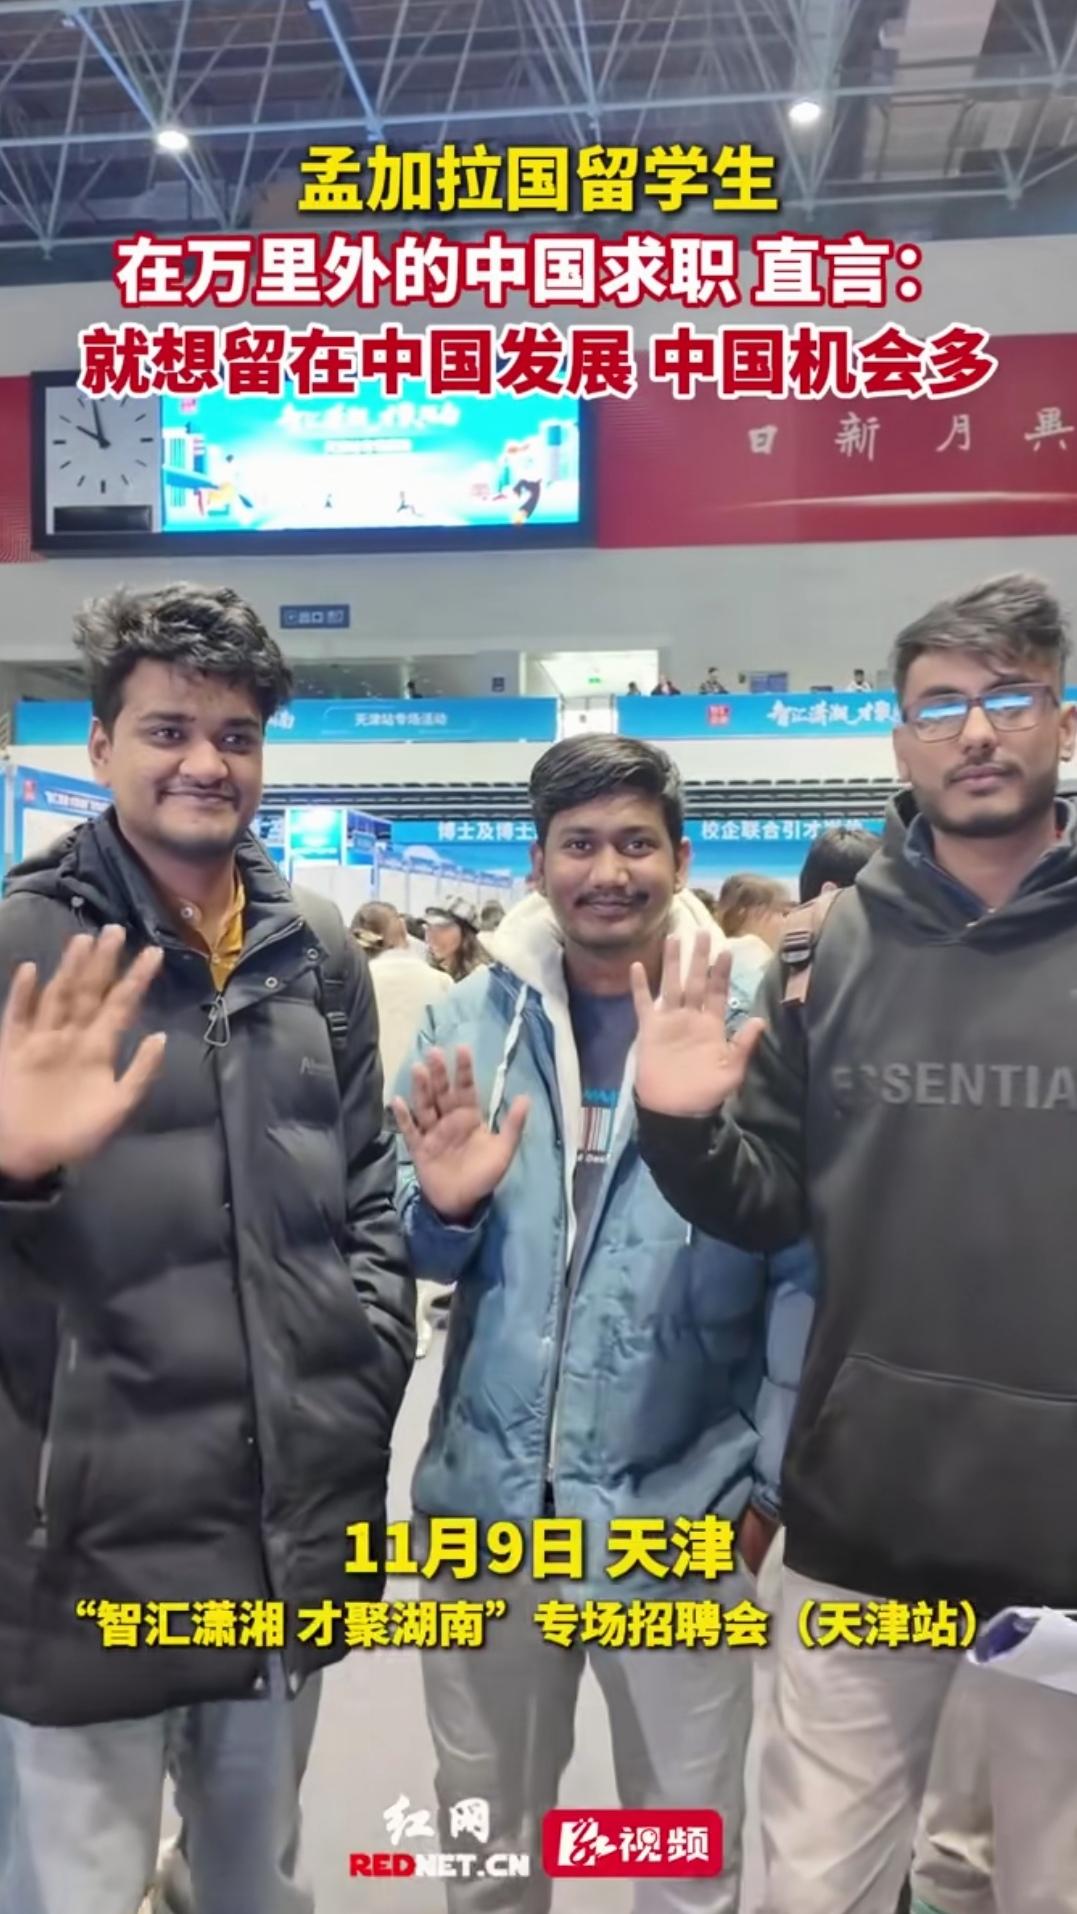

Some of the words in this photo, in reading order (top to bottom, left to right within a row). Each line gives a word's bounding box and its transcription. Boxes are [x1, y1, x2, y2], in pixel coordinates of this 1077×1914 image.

[438, 820, 538, 842] 博士及博士
